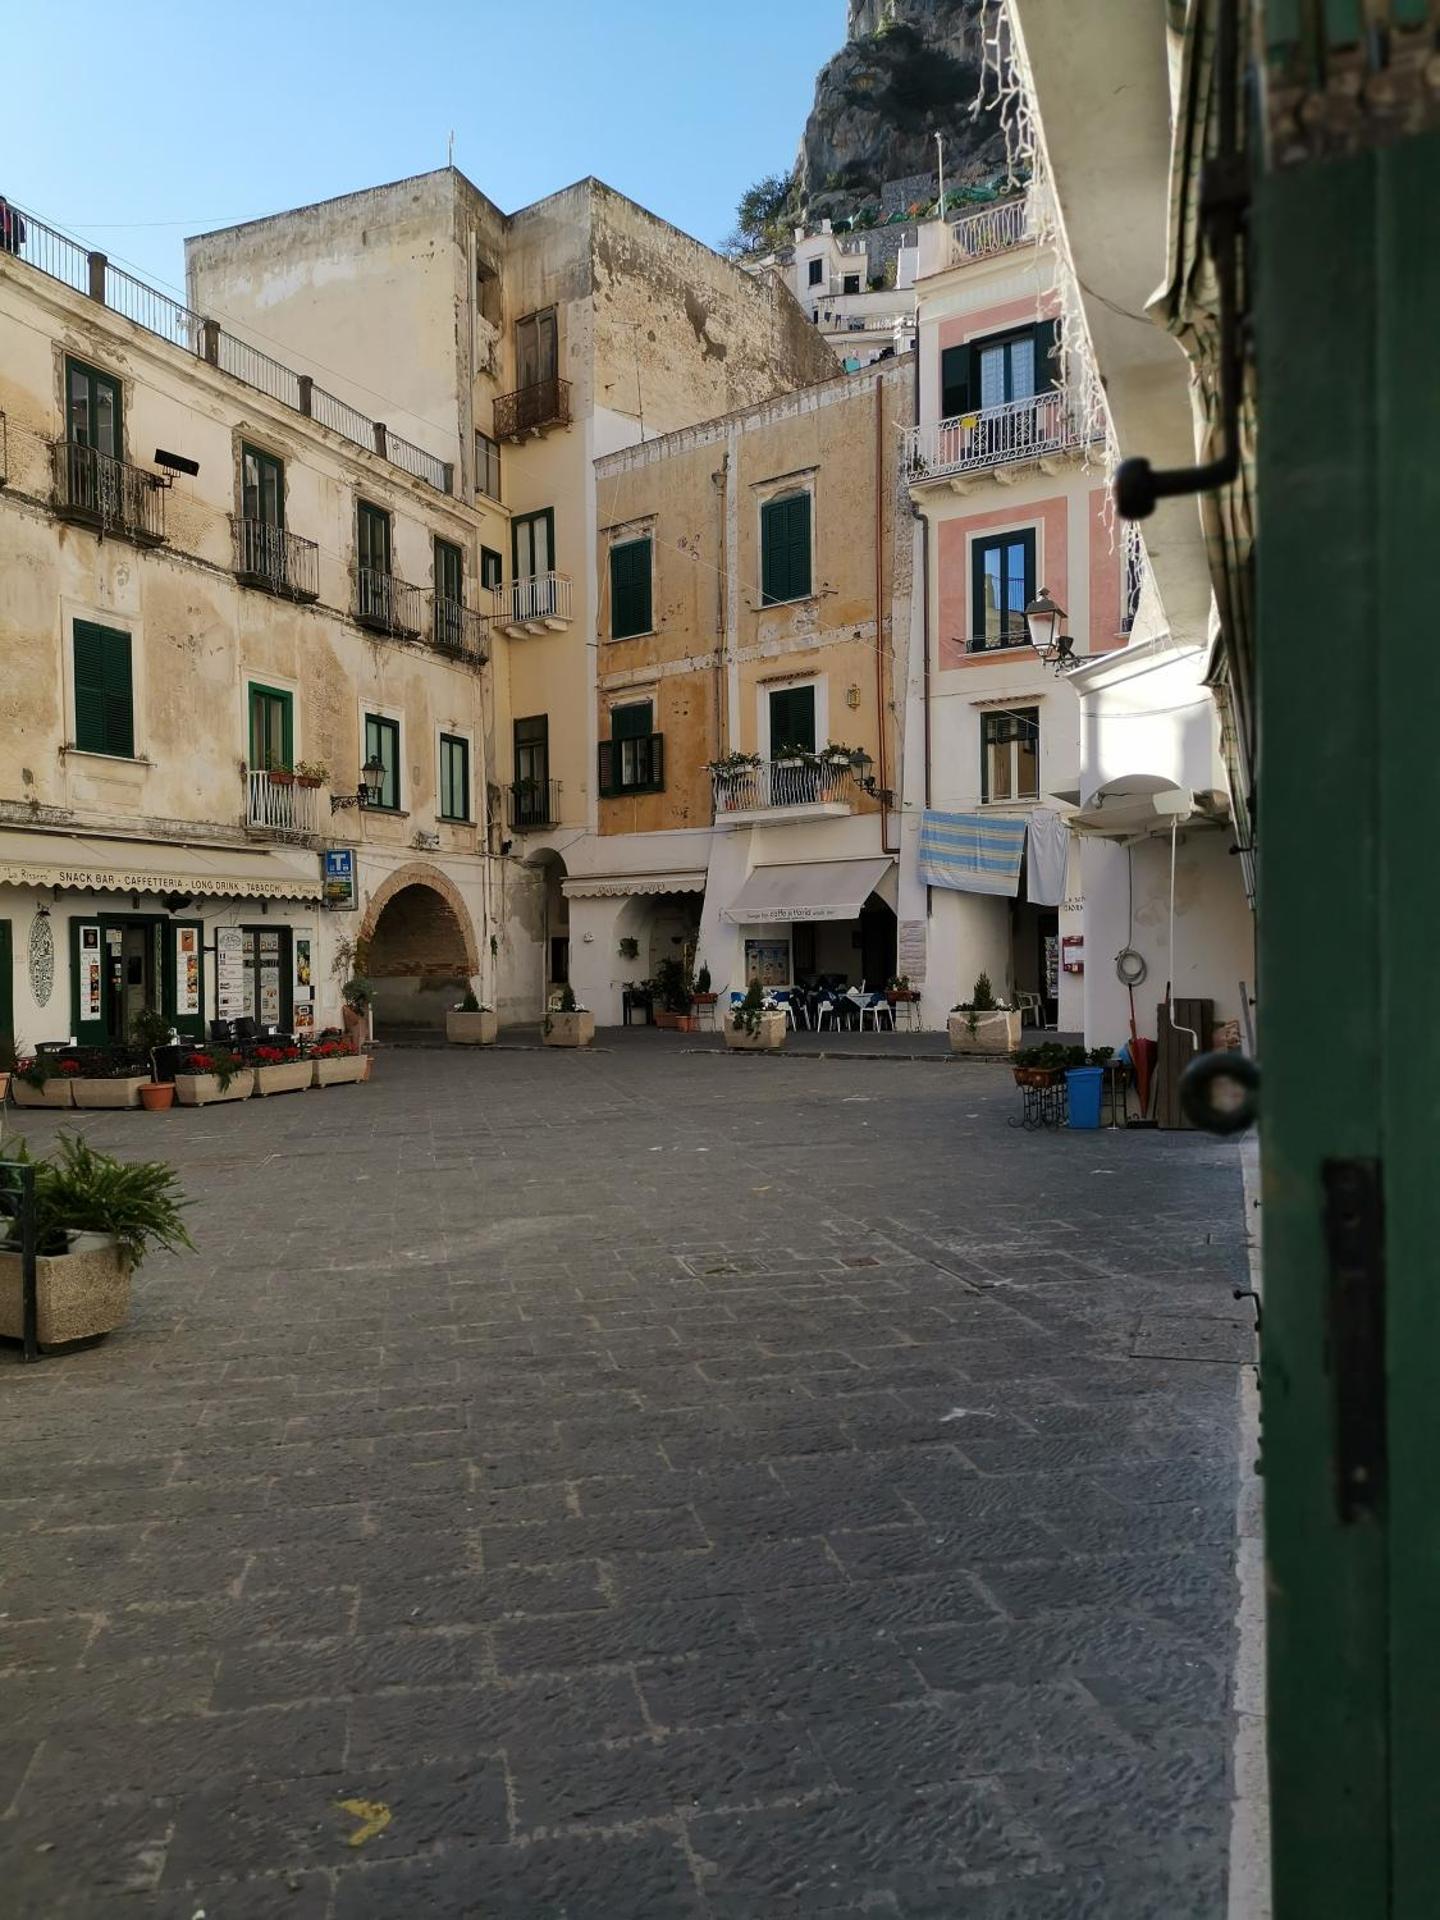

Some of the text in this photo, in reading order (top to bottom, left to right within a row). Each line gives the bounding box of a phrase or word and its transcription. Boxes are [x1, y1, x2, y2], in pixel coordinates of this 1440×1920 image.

[59, 871, 92, 883] SNACK
[95, 874, 115, 884] BAR
[124, 875, 183, 887] CAFFETTERIA
[191, 880, 213, 890] LONG
[215, 881, 239, 891] DRINK
